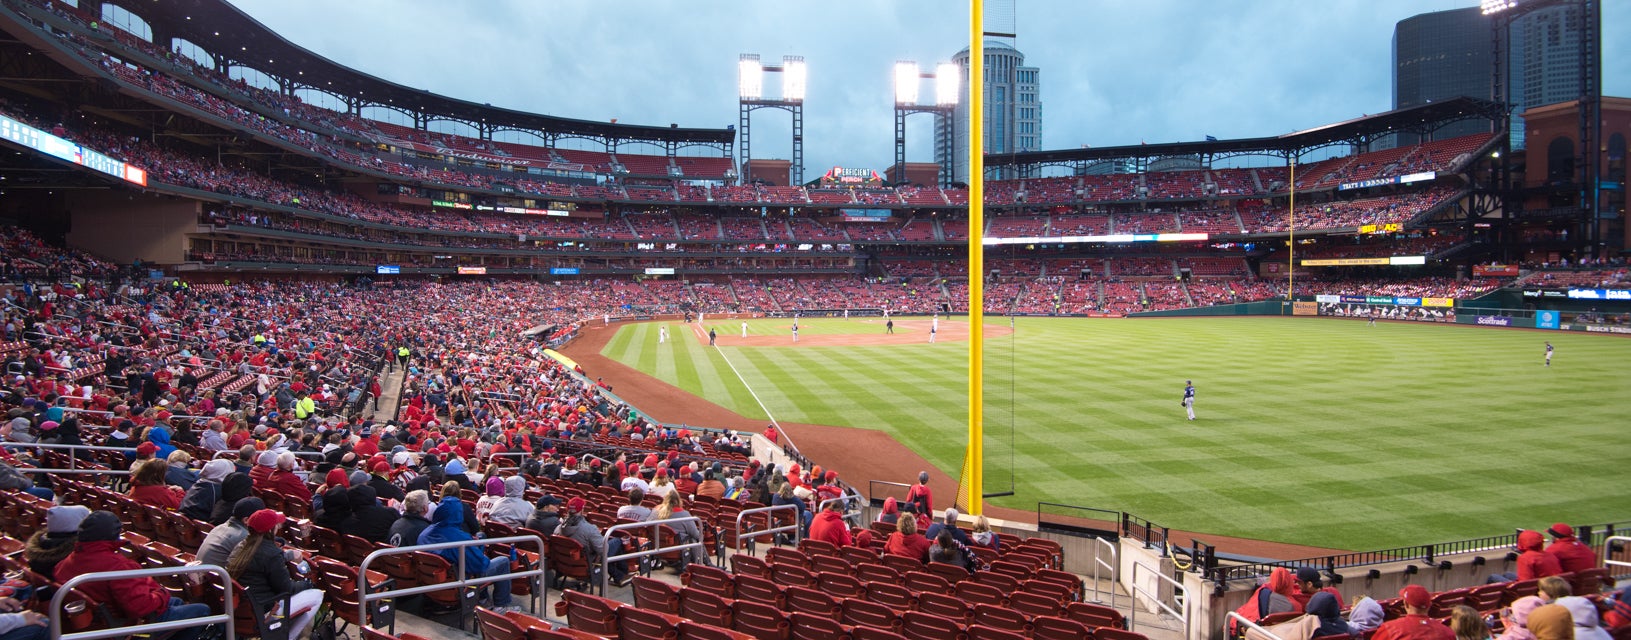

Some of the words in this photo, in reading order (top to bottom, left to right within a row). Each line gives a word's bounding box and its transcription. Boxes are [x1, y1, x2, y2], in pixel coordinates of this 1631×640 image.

[436, 148, 531, 165] Budweiser
[1361, 223, 1377, 234] BIG
[1477, 315, 1508, 326] Scottrade
